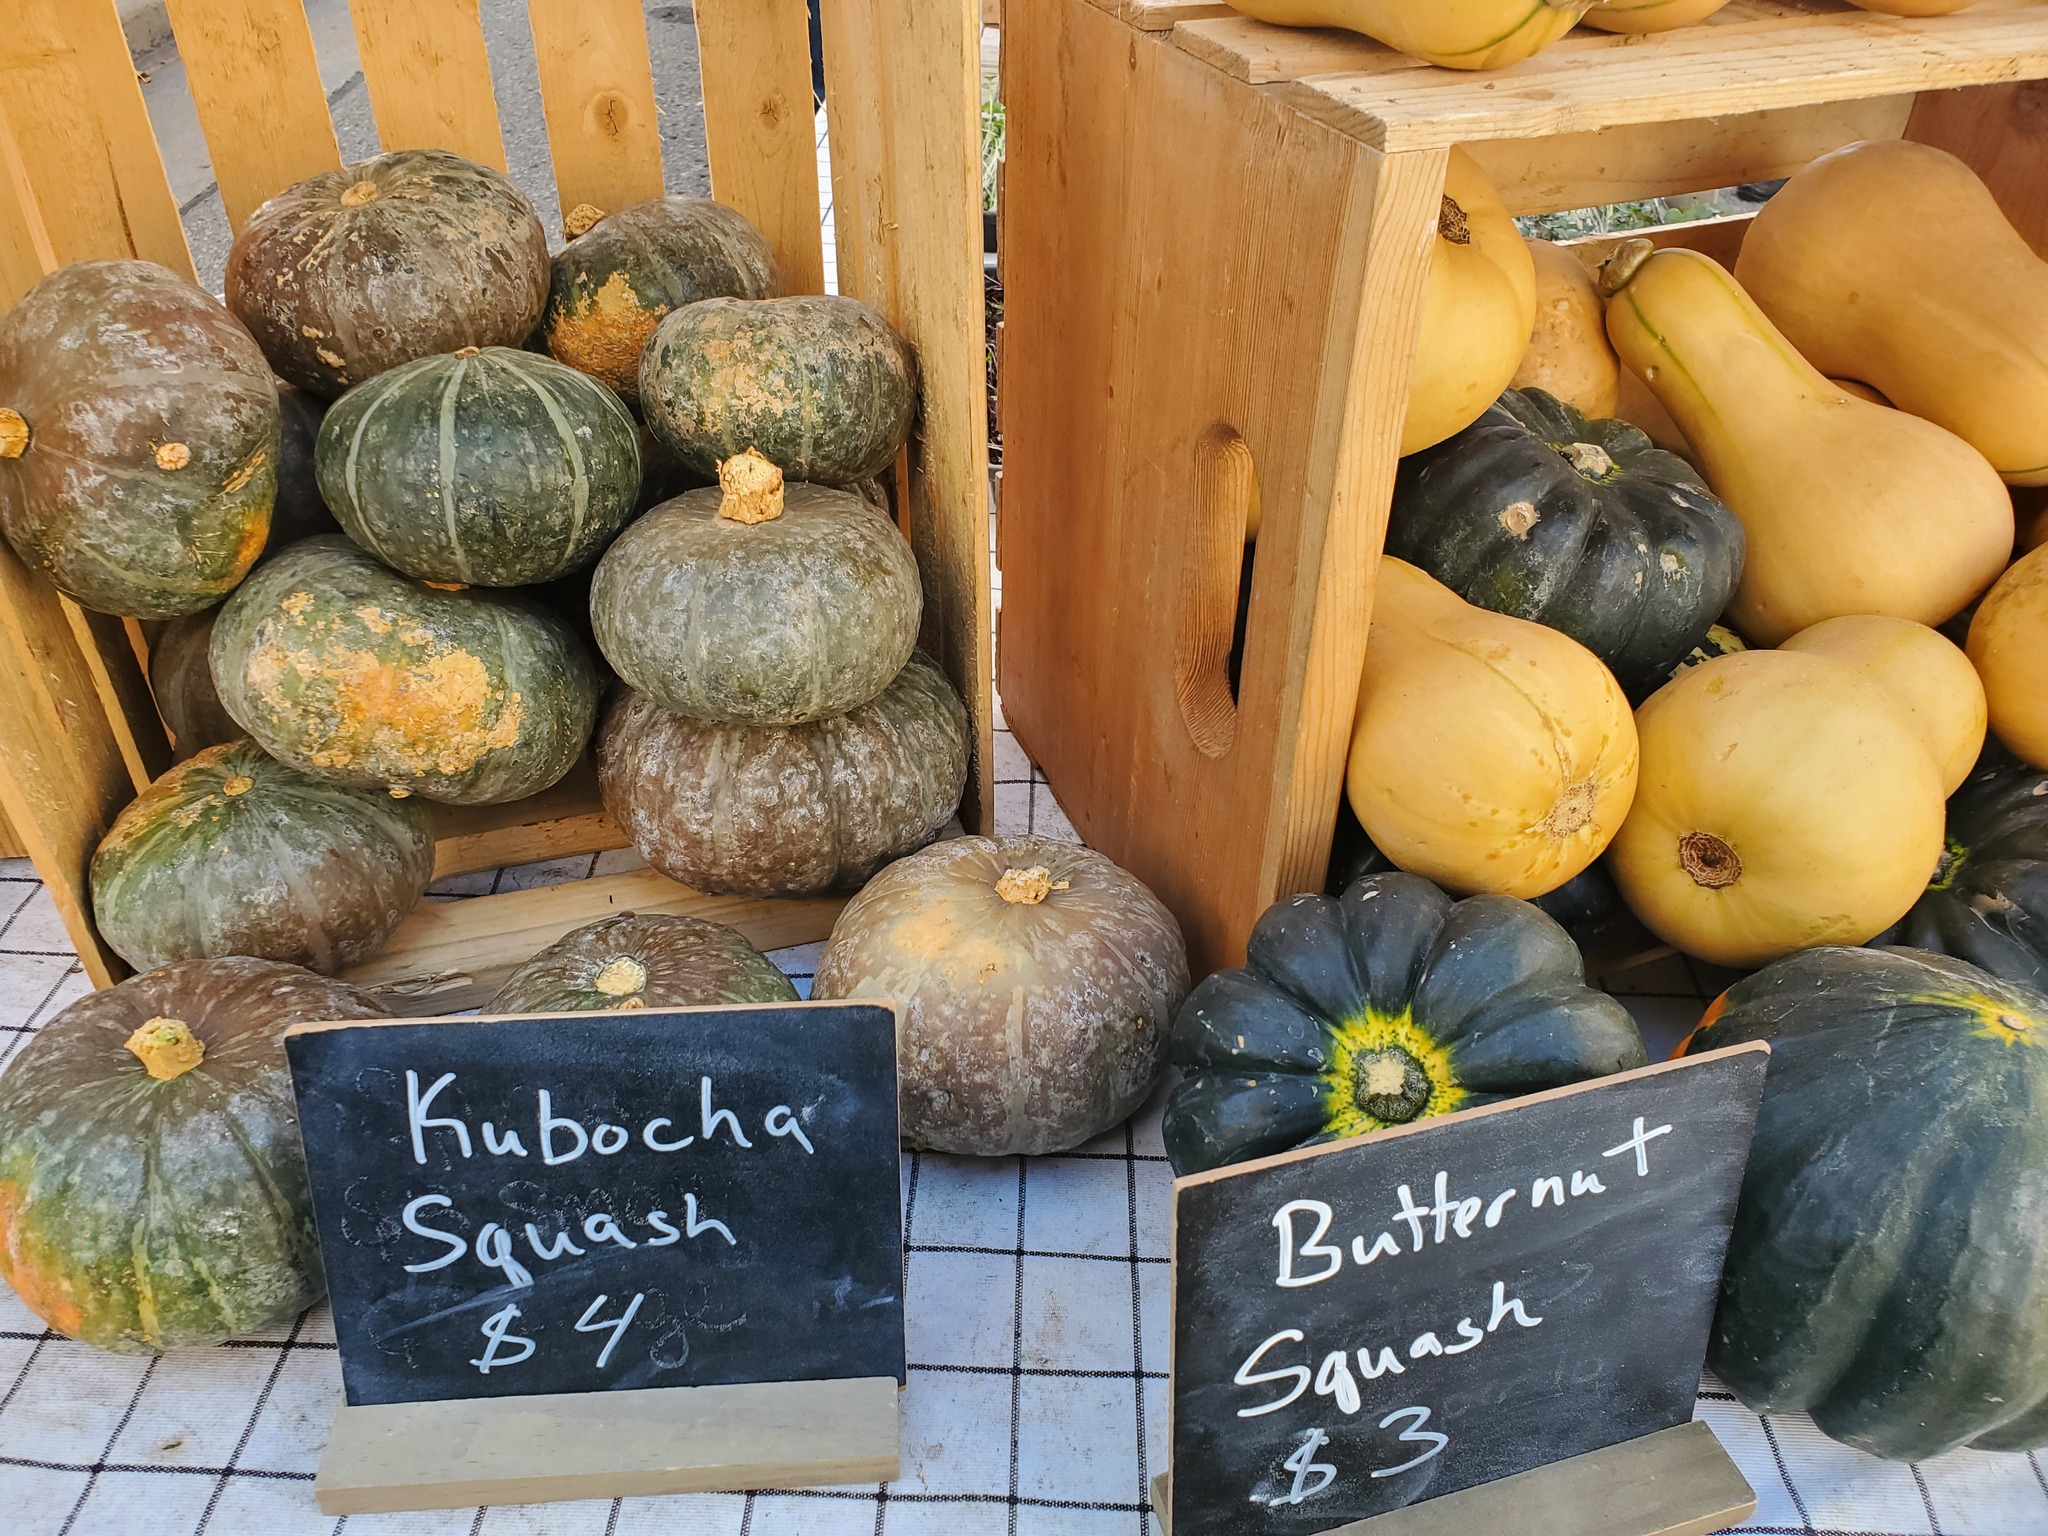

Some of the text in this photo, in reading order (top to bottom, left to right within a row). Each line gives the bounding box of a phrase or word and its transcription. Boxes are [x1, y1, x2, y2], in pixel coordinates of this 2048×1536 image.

[404, 1069, 815, 1165] Kubocha
[402, 1192, 737, 1287] Squash
[1233, 1281, 1543, 1417] Squash
